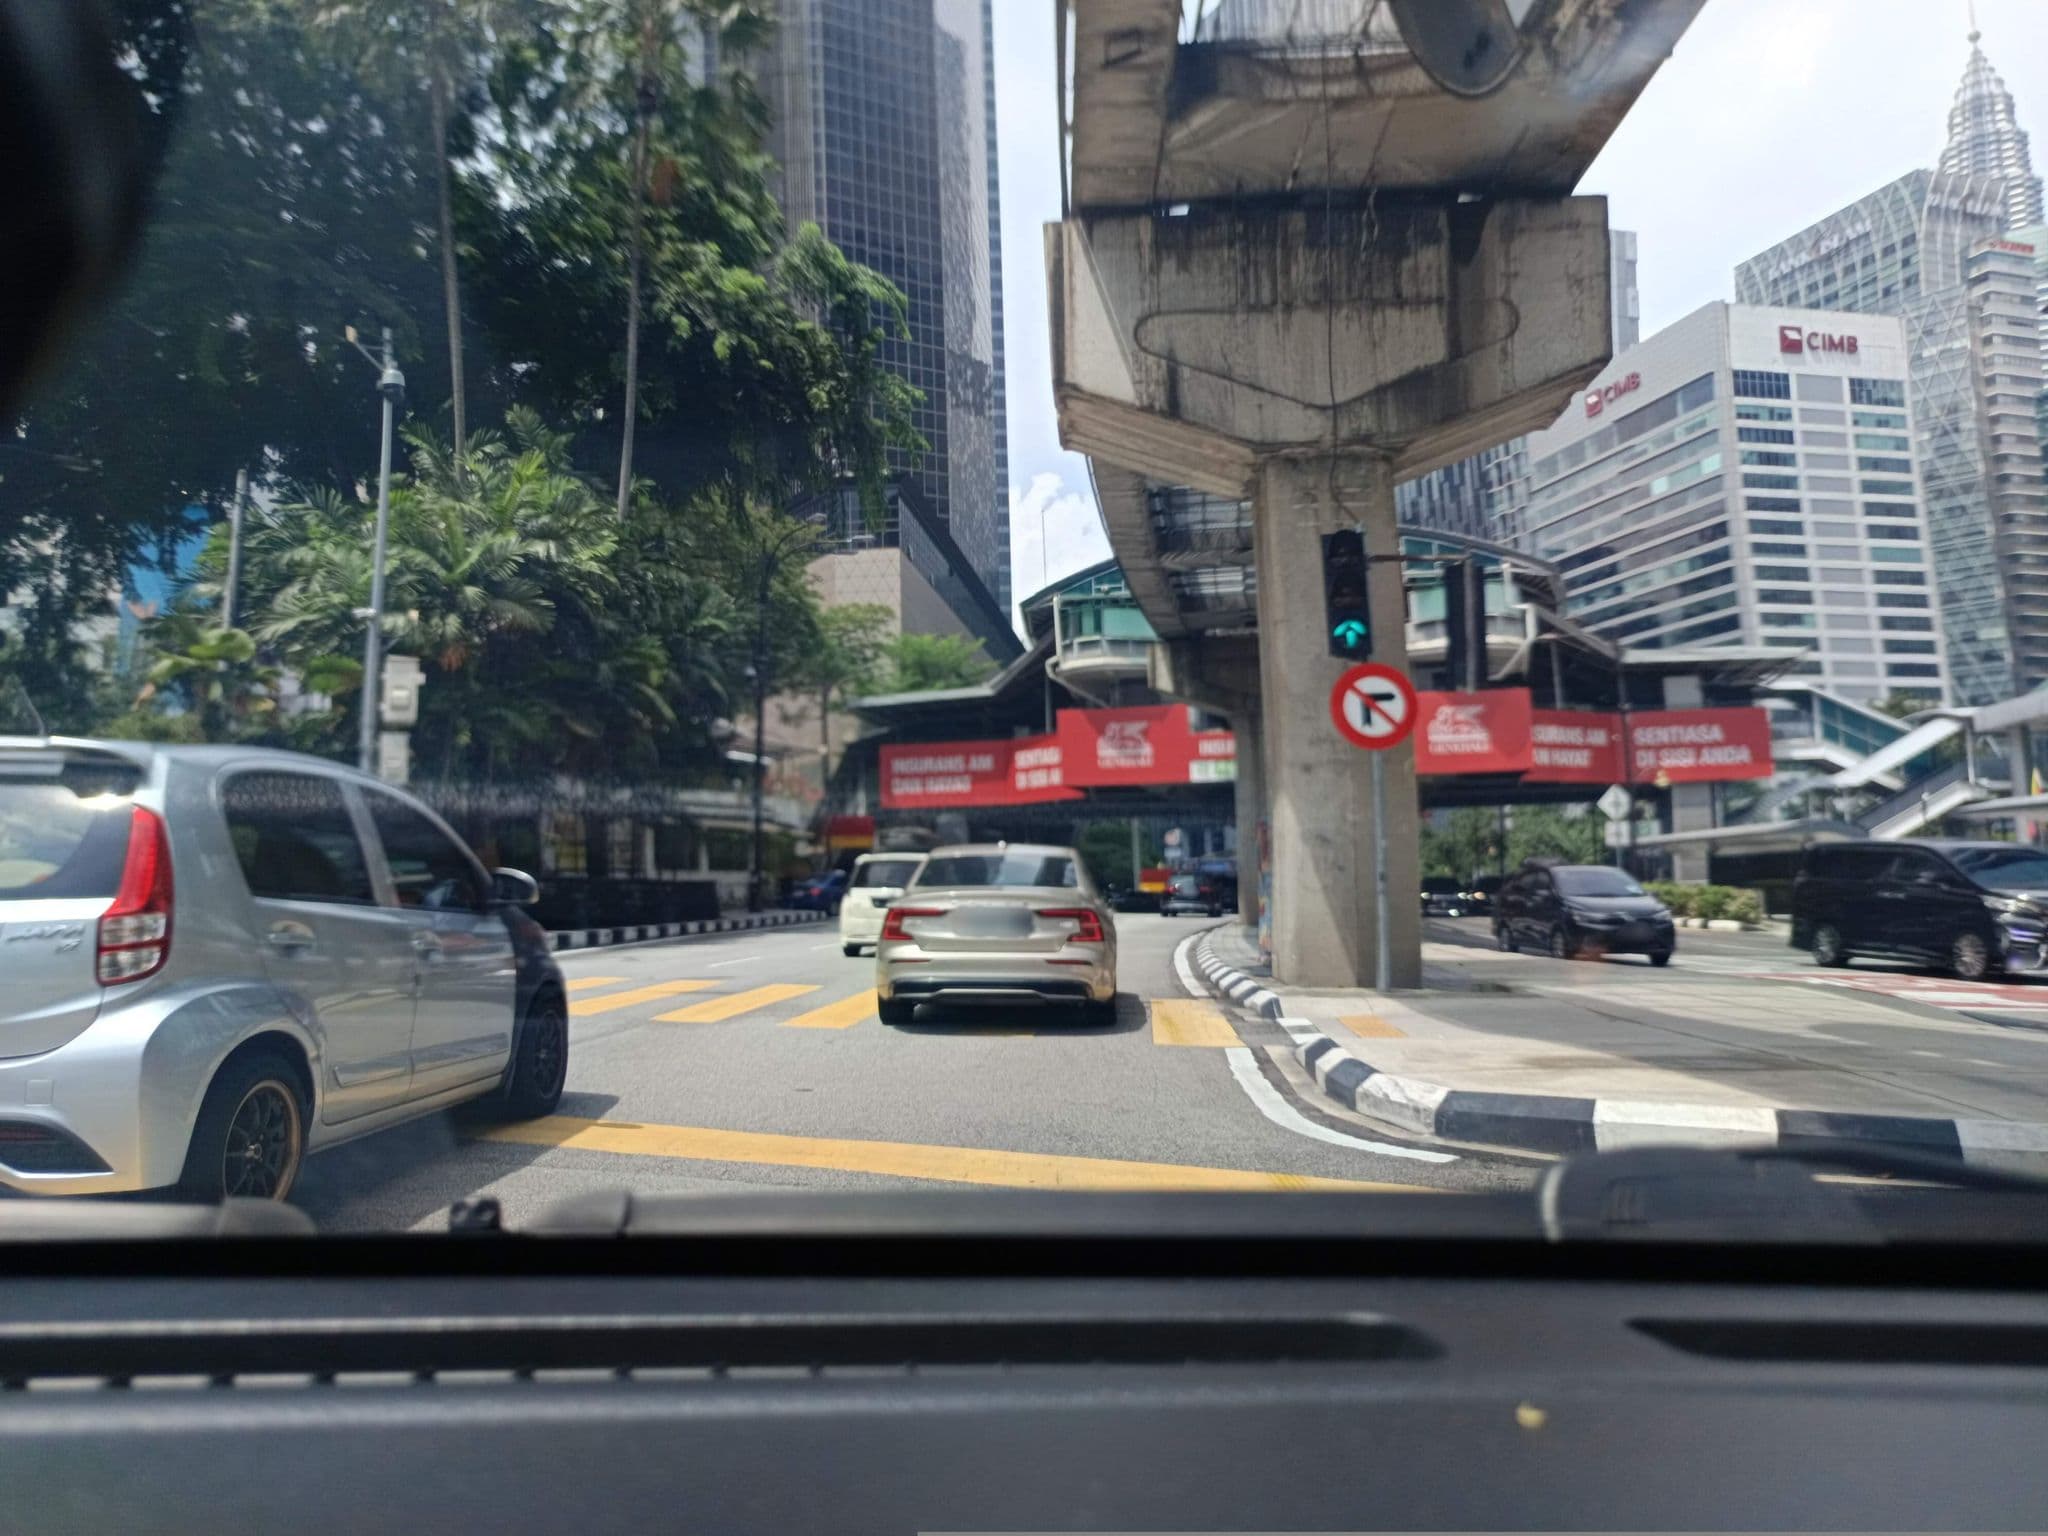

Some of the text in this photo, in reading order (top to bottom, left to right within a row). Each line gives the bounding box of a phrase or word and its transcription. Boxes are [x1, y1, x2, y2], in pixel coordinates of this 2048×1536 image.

[1807, 331, 1858, 354] CIMB
[1604, 372, 1641, 403] CIMB
[1635, 724, 1724, 745] SENTIASA
[1636, 749, 1656, 768] DI
[1700, 746, 1751, 765] ANDA
